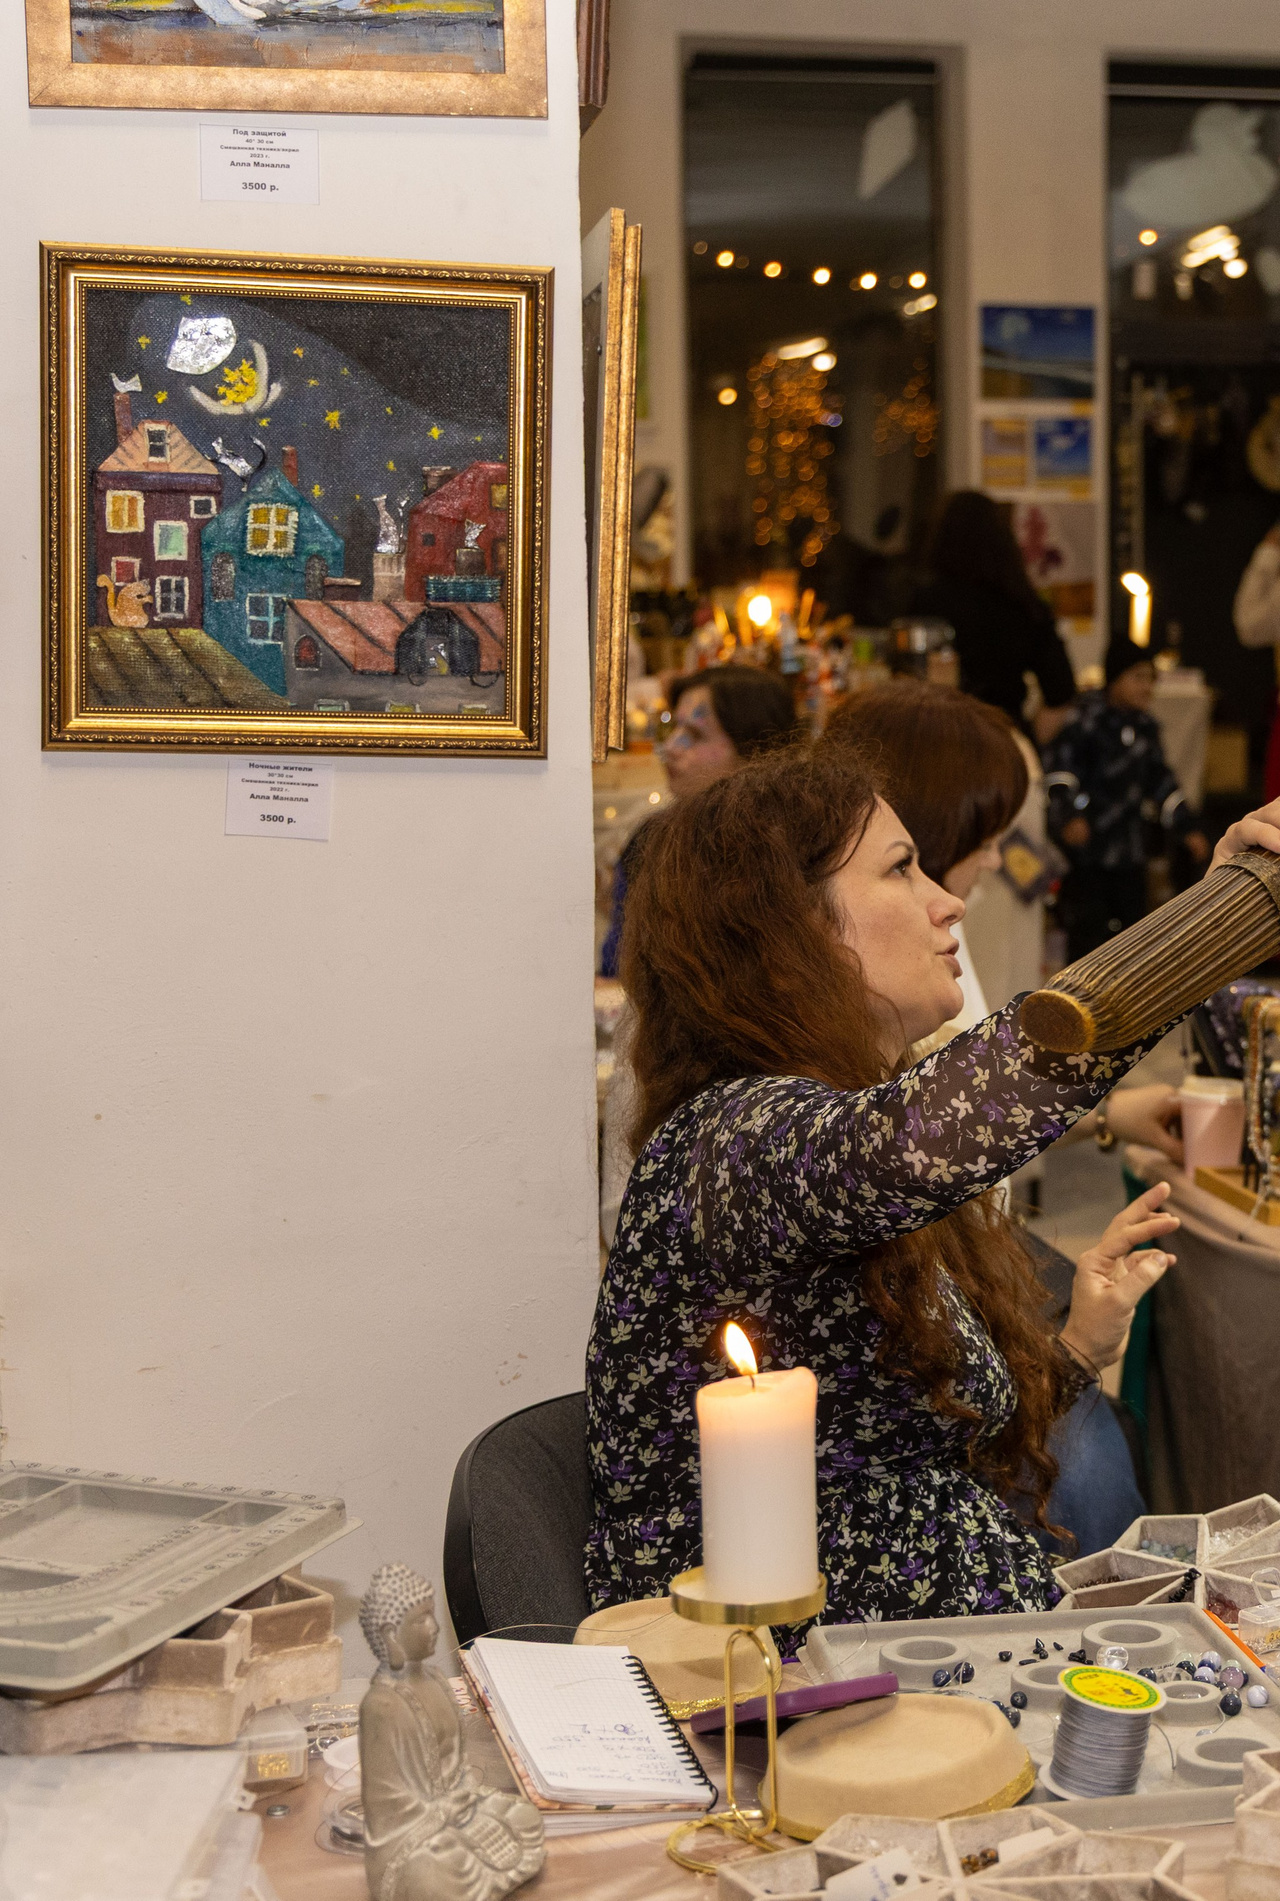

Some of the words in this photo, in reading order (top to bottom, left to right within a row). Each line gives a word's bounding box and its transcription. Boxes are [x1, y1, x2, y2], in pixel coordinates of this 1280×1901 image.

[232, 128, 249, 137] Под
[253, 161, 291, 169] Маналла
[242, 182, 267, 190] 3500
[270, 184, 279, 192] р.
[248, 762, 281, 770] Ночные
[260, 814, 285, 822] 3500
